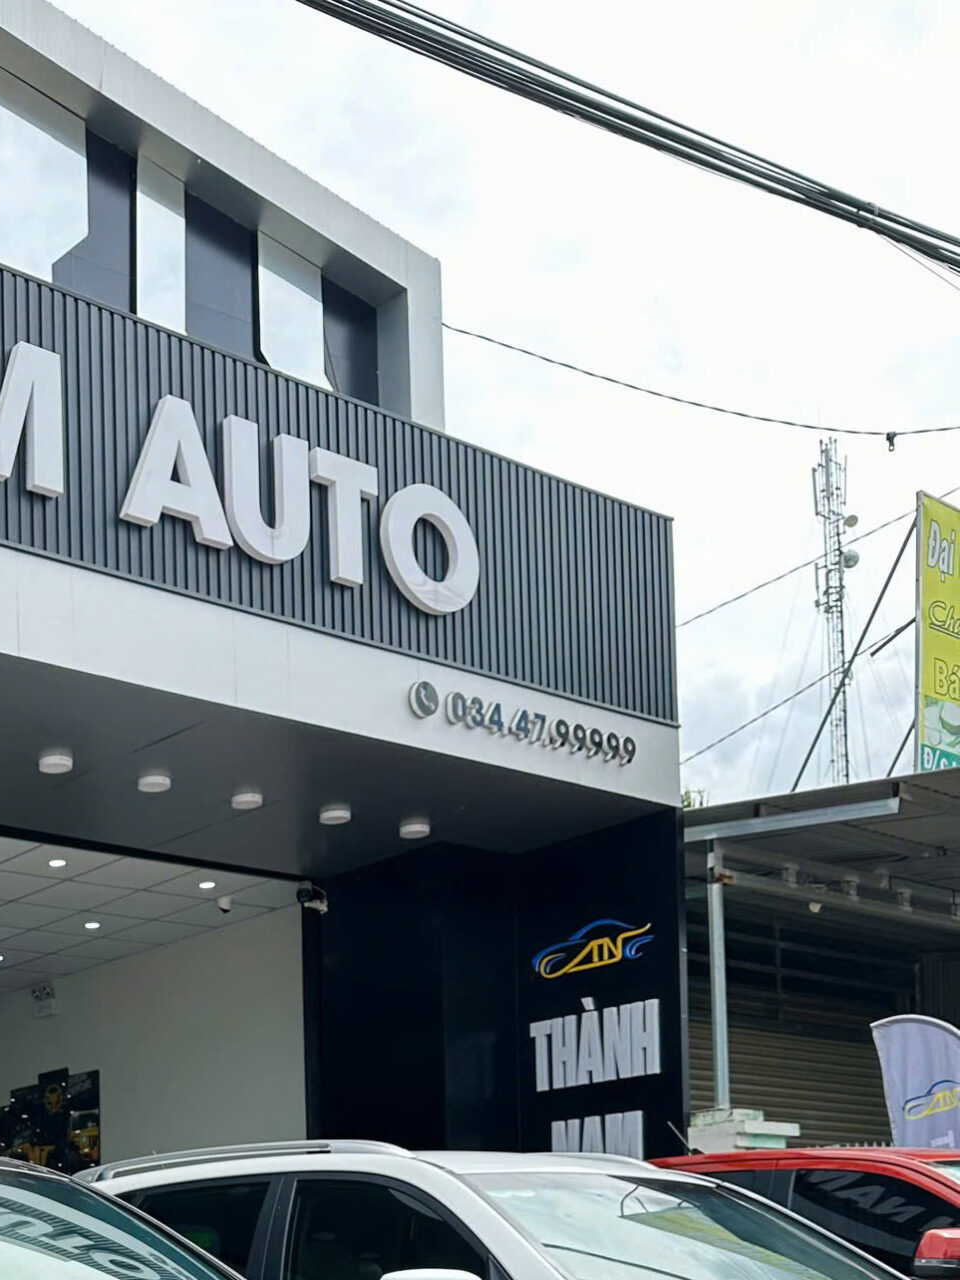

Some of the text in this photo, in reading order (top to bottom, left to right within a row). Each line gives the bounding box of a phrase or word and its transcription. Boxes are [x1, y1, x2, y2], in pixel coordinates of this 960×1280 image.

[120, 394, 480, 616] AUTO
[926, 518, 956, 583] Đại
[445, 691, 636, 766] 034.47.99999
[529, 997, 661, 1092] THÀNH
